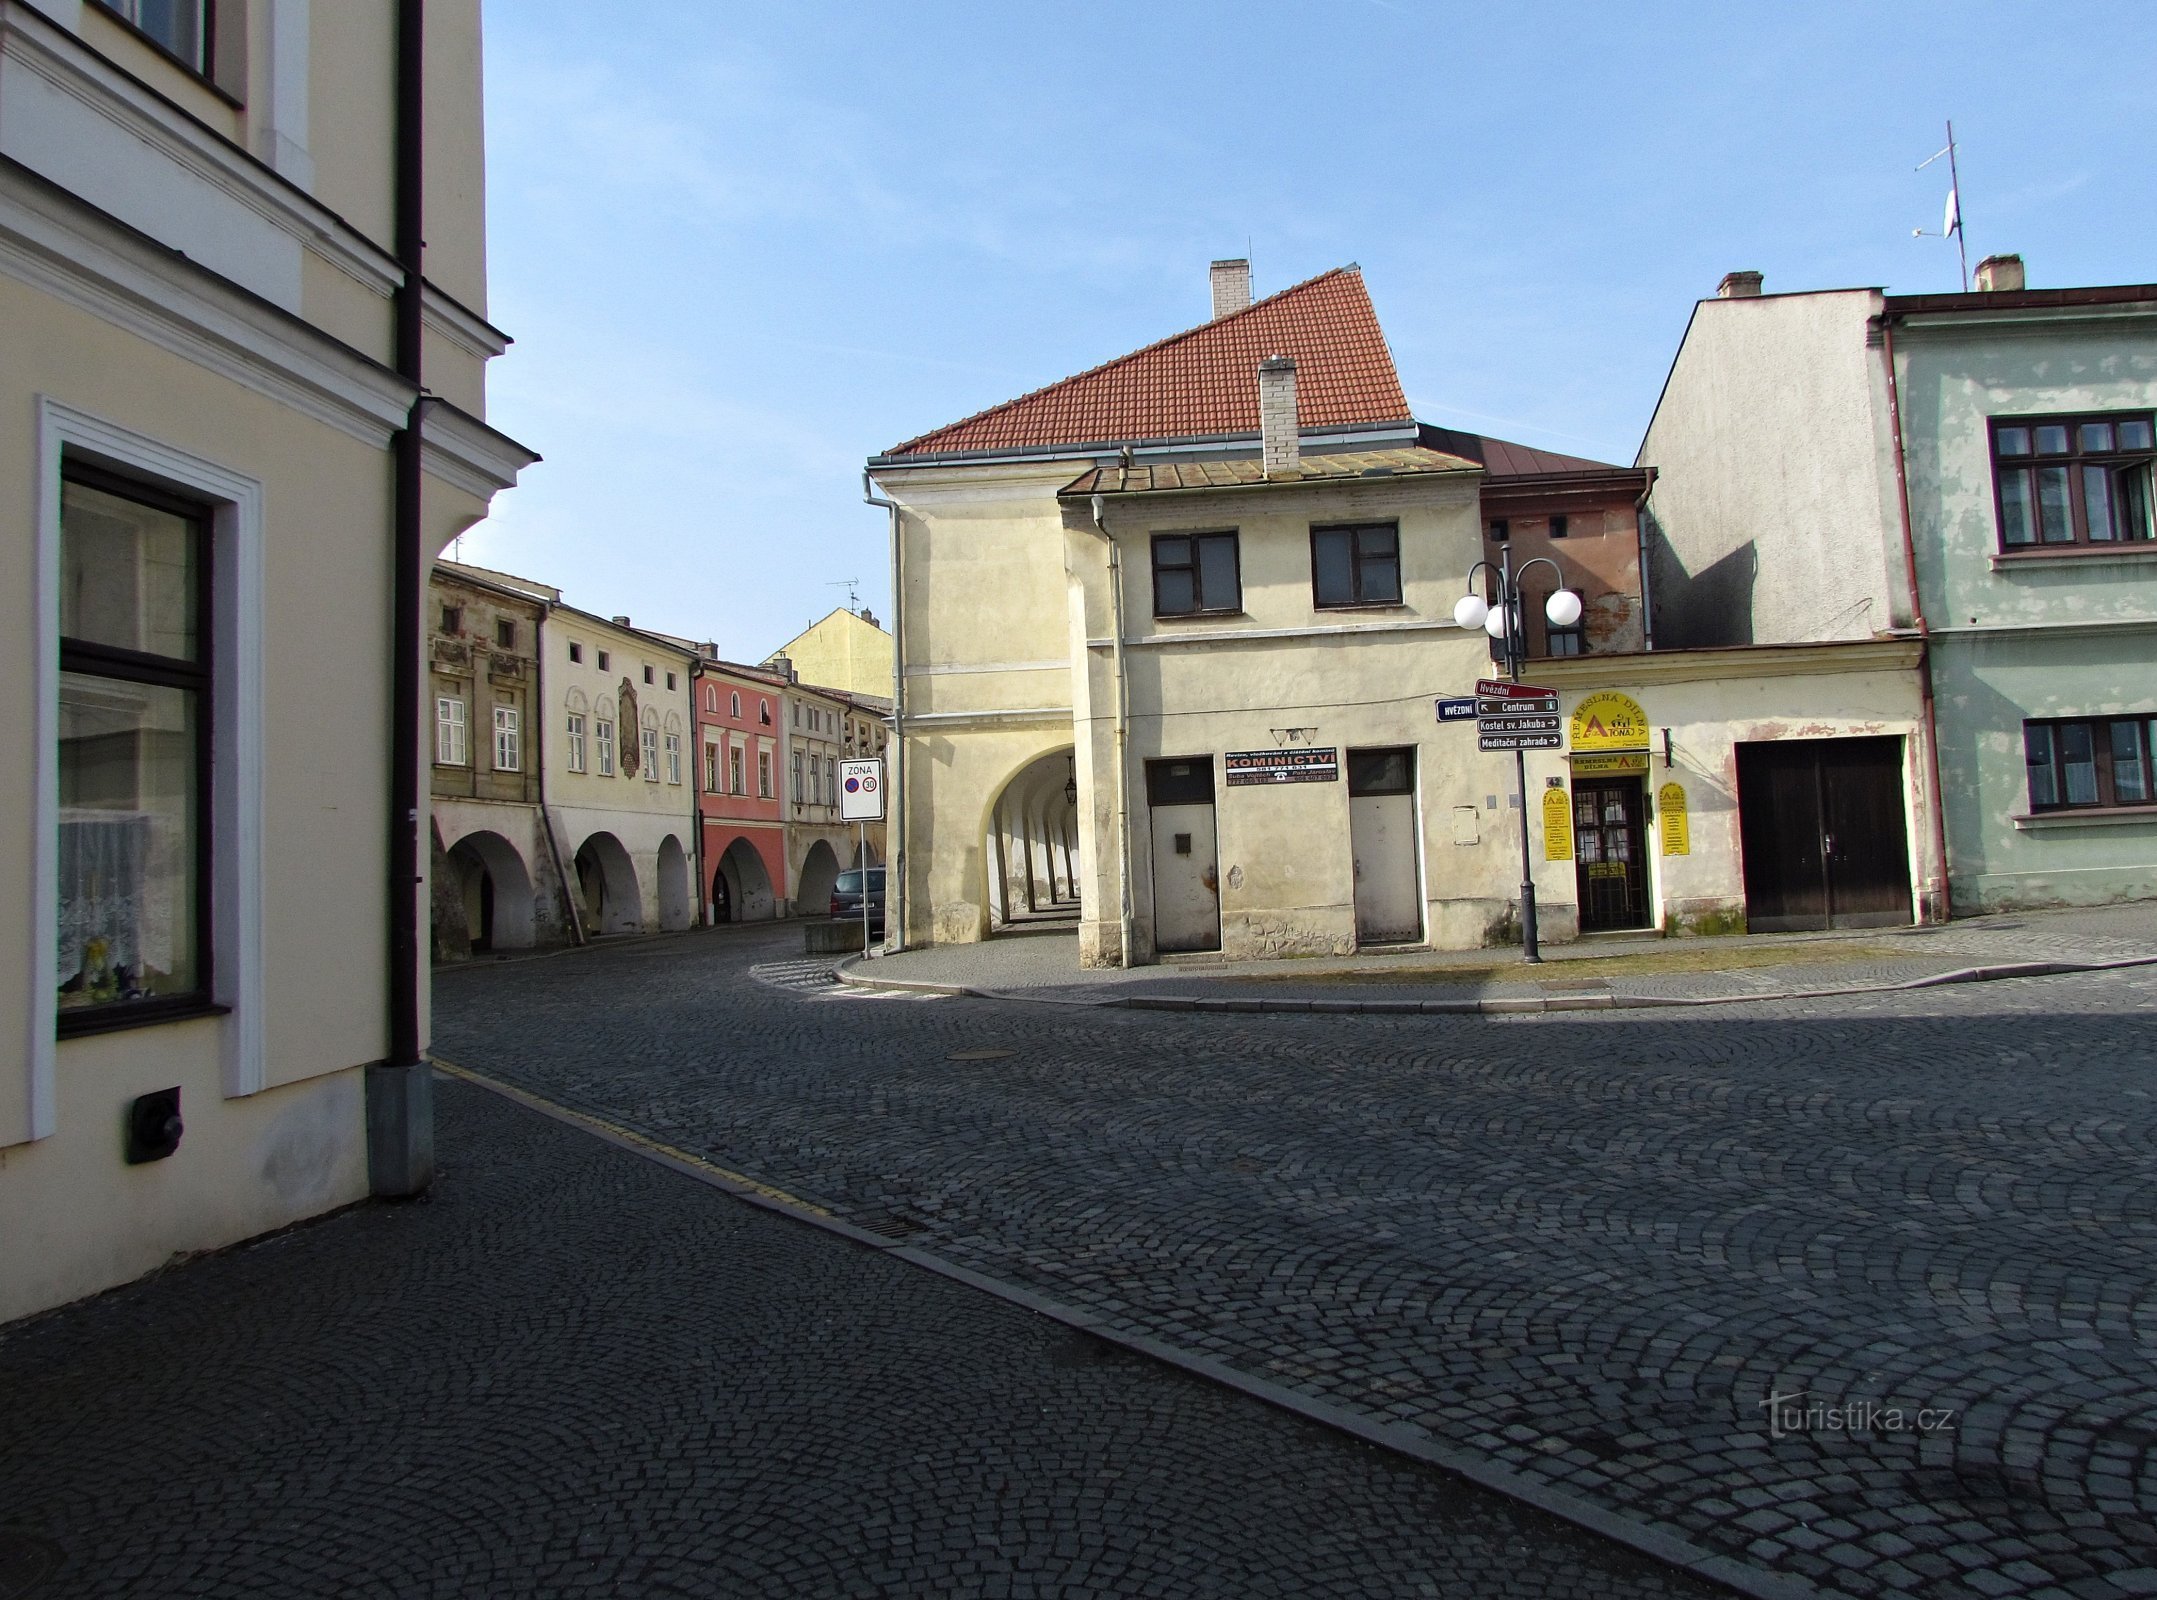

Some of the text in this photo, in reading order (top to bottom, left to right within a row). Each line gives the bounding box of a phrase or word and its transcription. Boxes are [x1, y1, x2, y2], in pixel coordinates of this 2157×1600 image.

[1480, 684, 1510, 696] Hvězdní
[1444, 704, 1473, 716] HVĚZDNÍ
[1502, 702, 1535, 712] Centrum
[1480, 720, 1504, 730] Kostel
[1518, 720, 1546, 730] Jakuba
[1482, 737, 1548, 748] Meditační zahrada
[1227, 753, 1336, 769] KOMINICTVÍ
[848, 764, 873, 775] ZÓNA
[865, 780, 875, 789] 30
